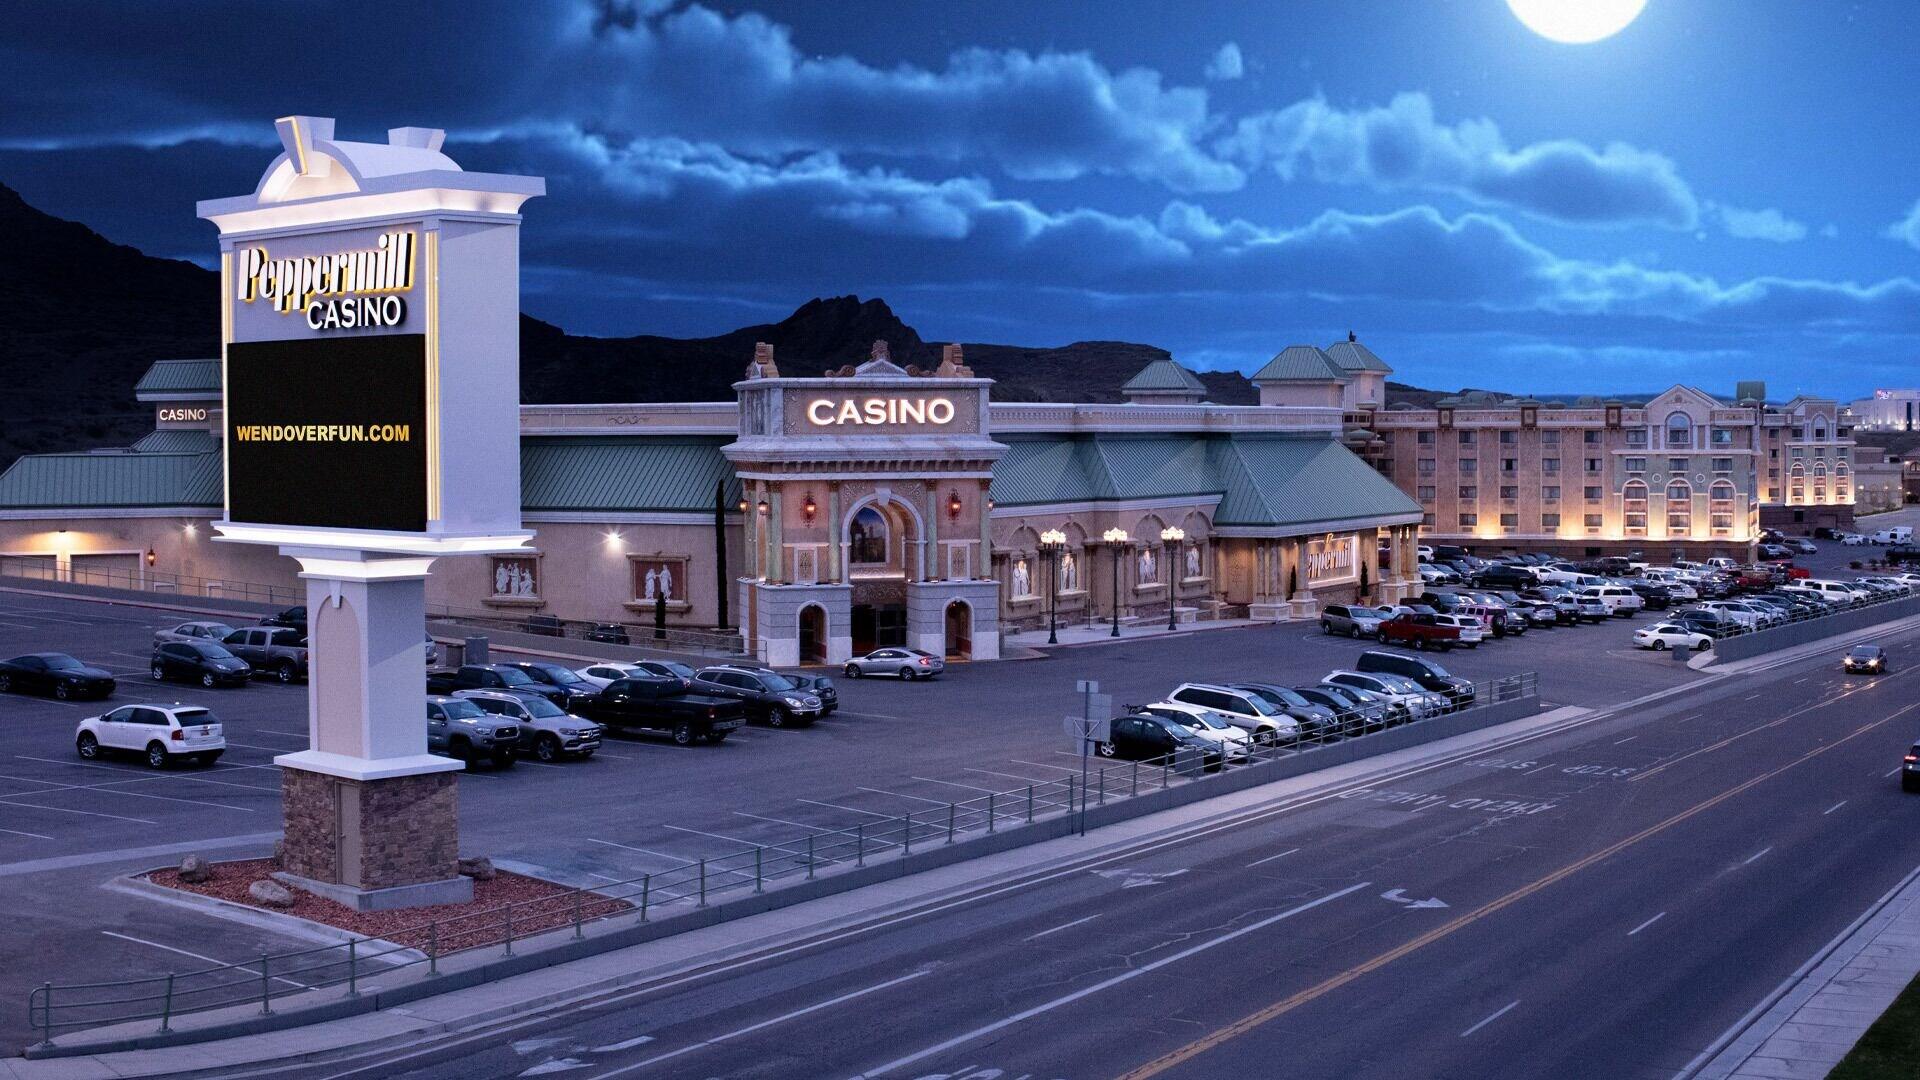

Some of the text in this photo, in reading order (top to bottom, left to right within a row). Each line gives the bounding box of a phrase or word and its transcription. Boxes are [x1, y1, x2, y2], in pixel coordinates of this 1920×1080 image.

[238, 233, 415, 312] Peppermill
[306, 295, 404, 330] CASINO
[160, 408, 207, 421] CASINO
[808, 398, 955, 426] CASINO
[237, 424, 410, 442] WENDOVERFUN.COM
